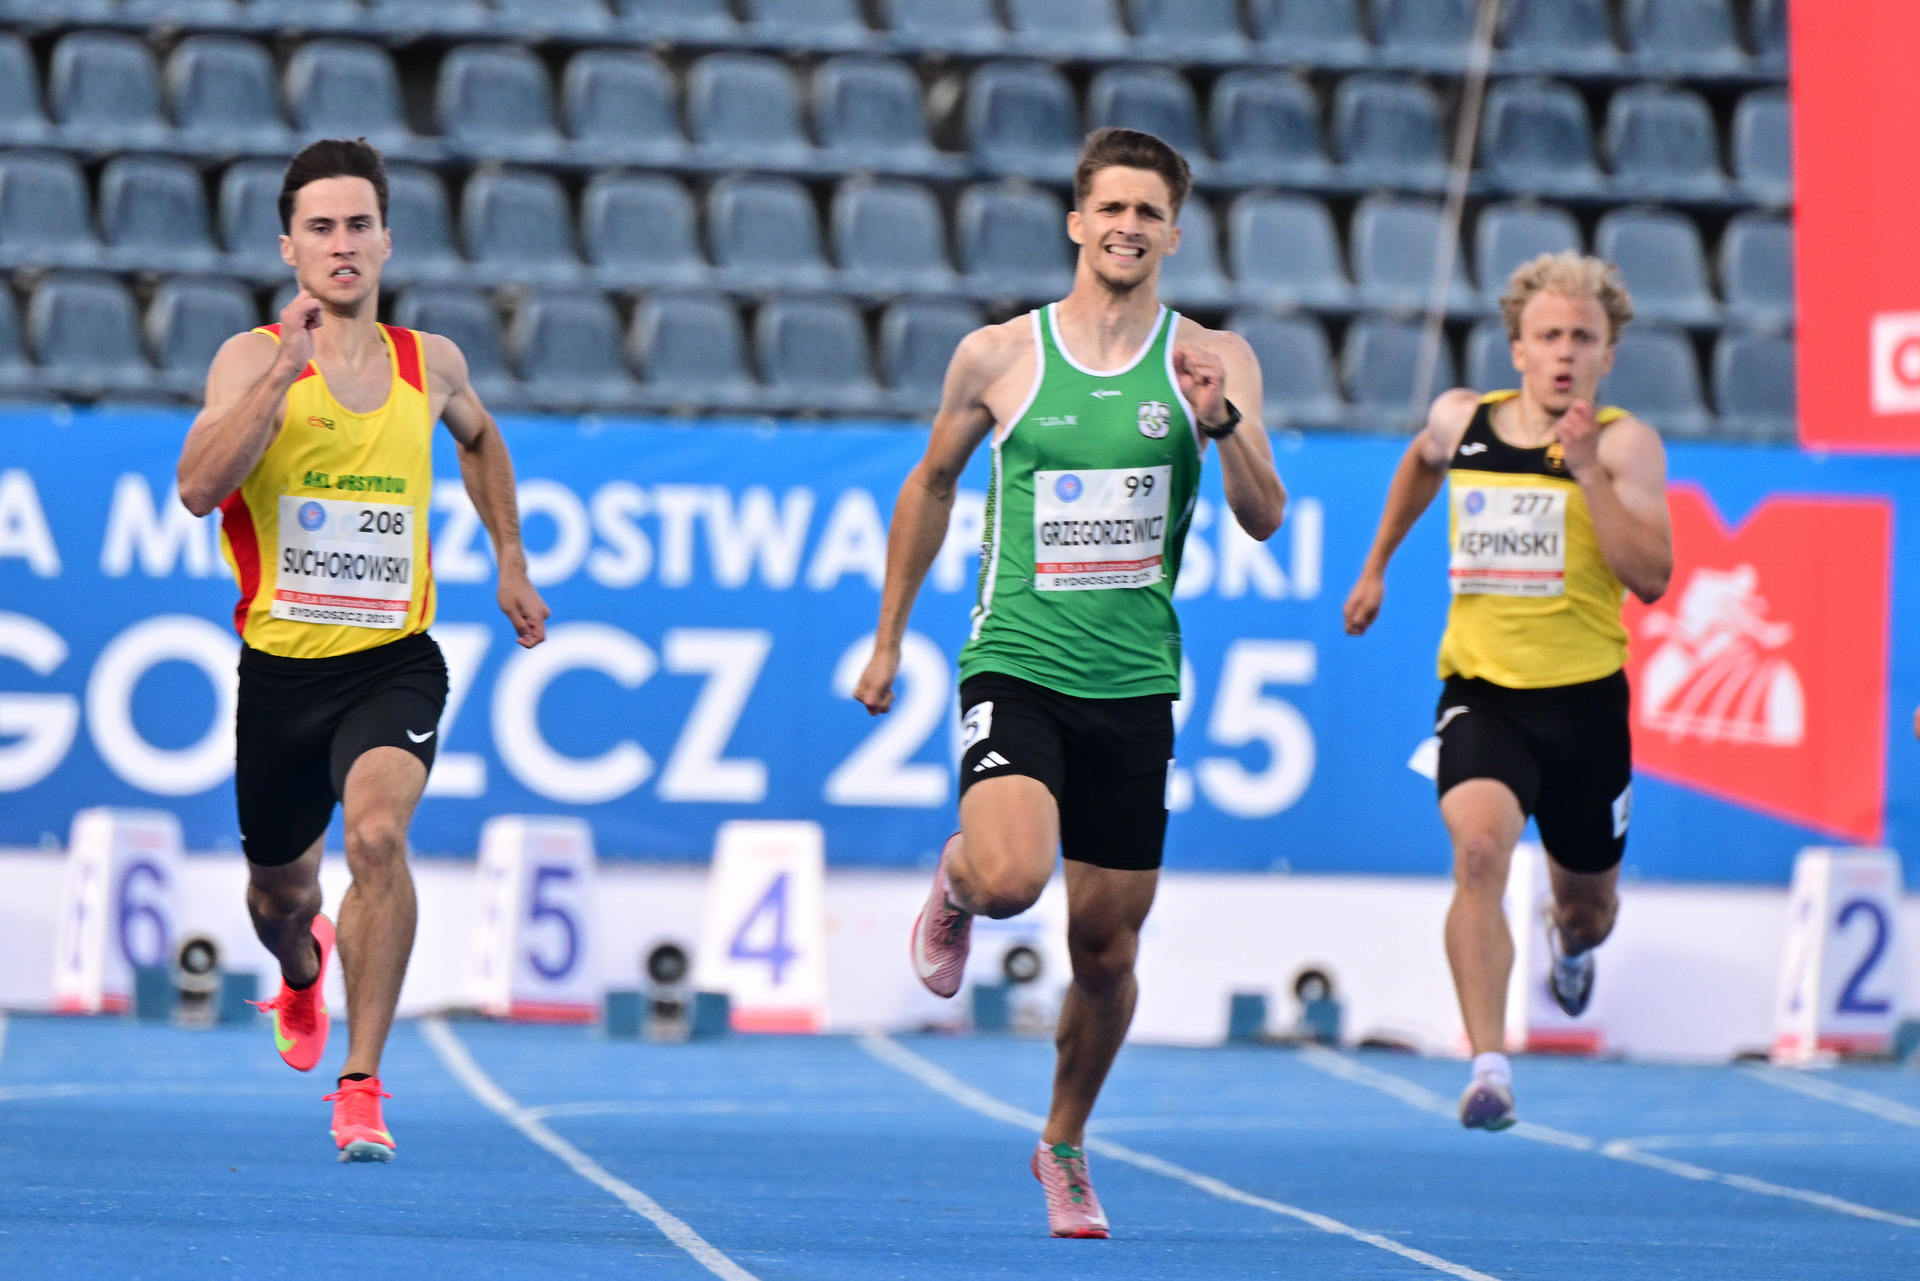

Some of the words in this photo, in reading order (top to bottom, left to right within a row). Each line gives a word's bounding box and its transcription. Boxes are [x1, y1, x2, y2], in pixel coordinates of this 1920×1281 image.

[1124, 474, 1155, 498] 99
[1512, 493, 1555, 516] 277
[358, 509, 406, 535] 208
[1041, 516, 1163, 547] GRZEGORZEWICZ
[283, 547, 410, 584] SUCHOROWSKI
[1053, 575, 1129, 587] BYDGOSZCZ
[289, 606, 362, 622] BYDGOSZCZ
[365, 613, 396, 624] 2025
[117, 860, 167, 969] 6
[530, 865, 580, 981] 5
[727, 871, 798, 986] 4
[1835, 899, 1893, 1015] 2
